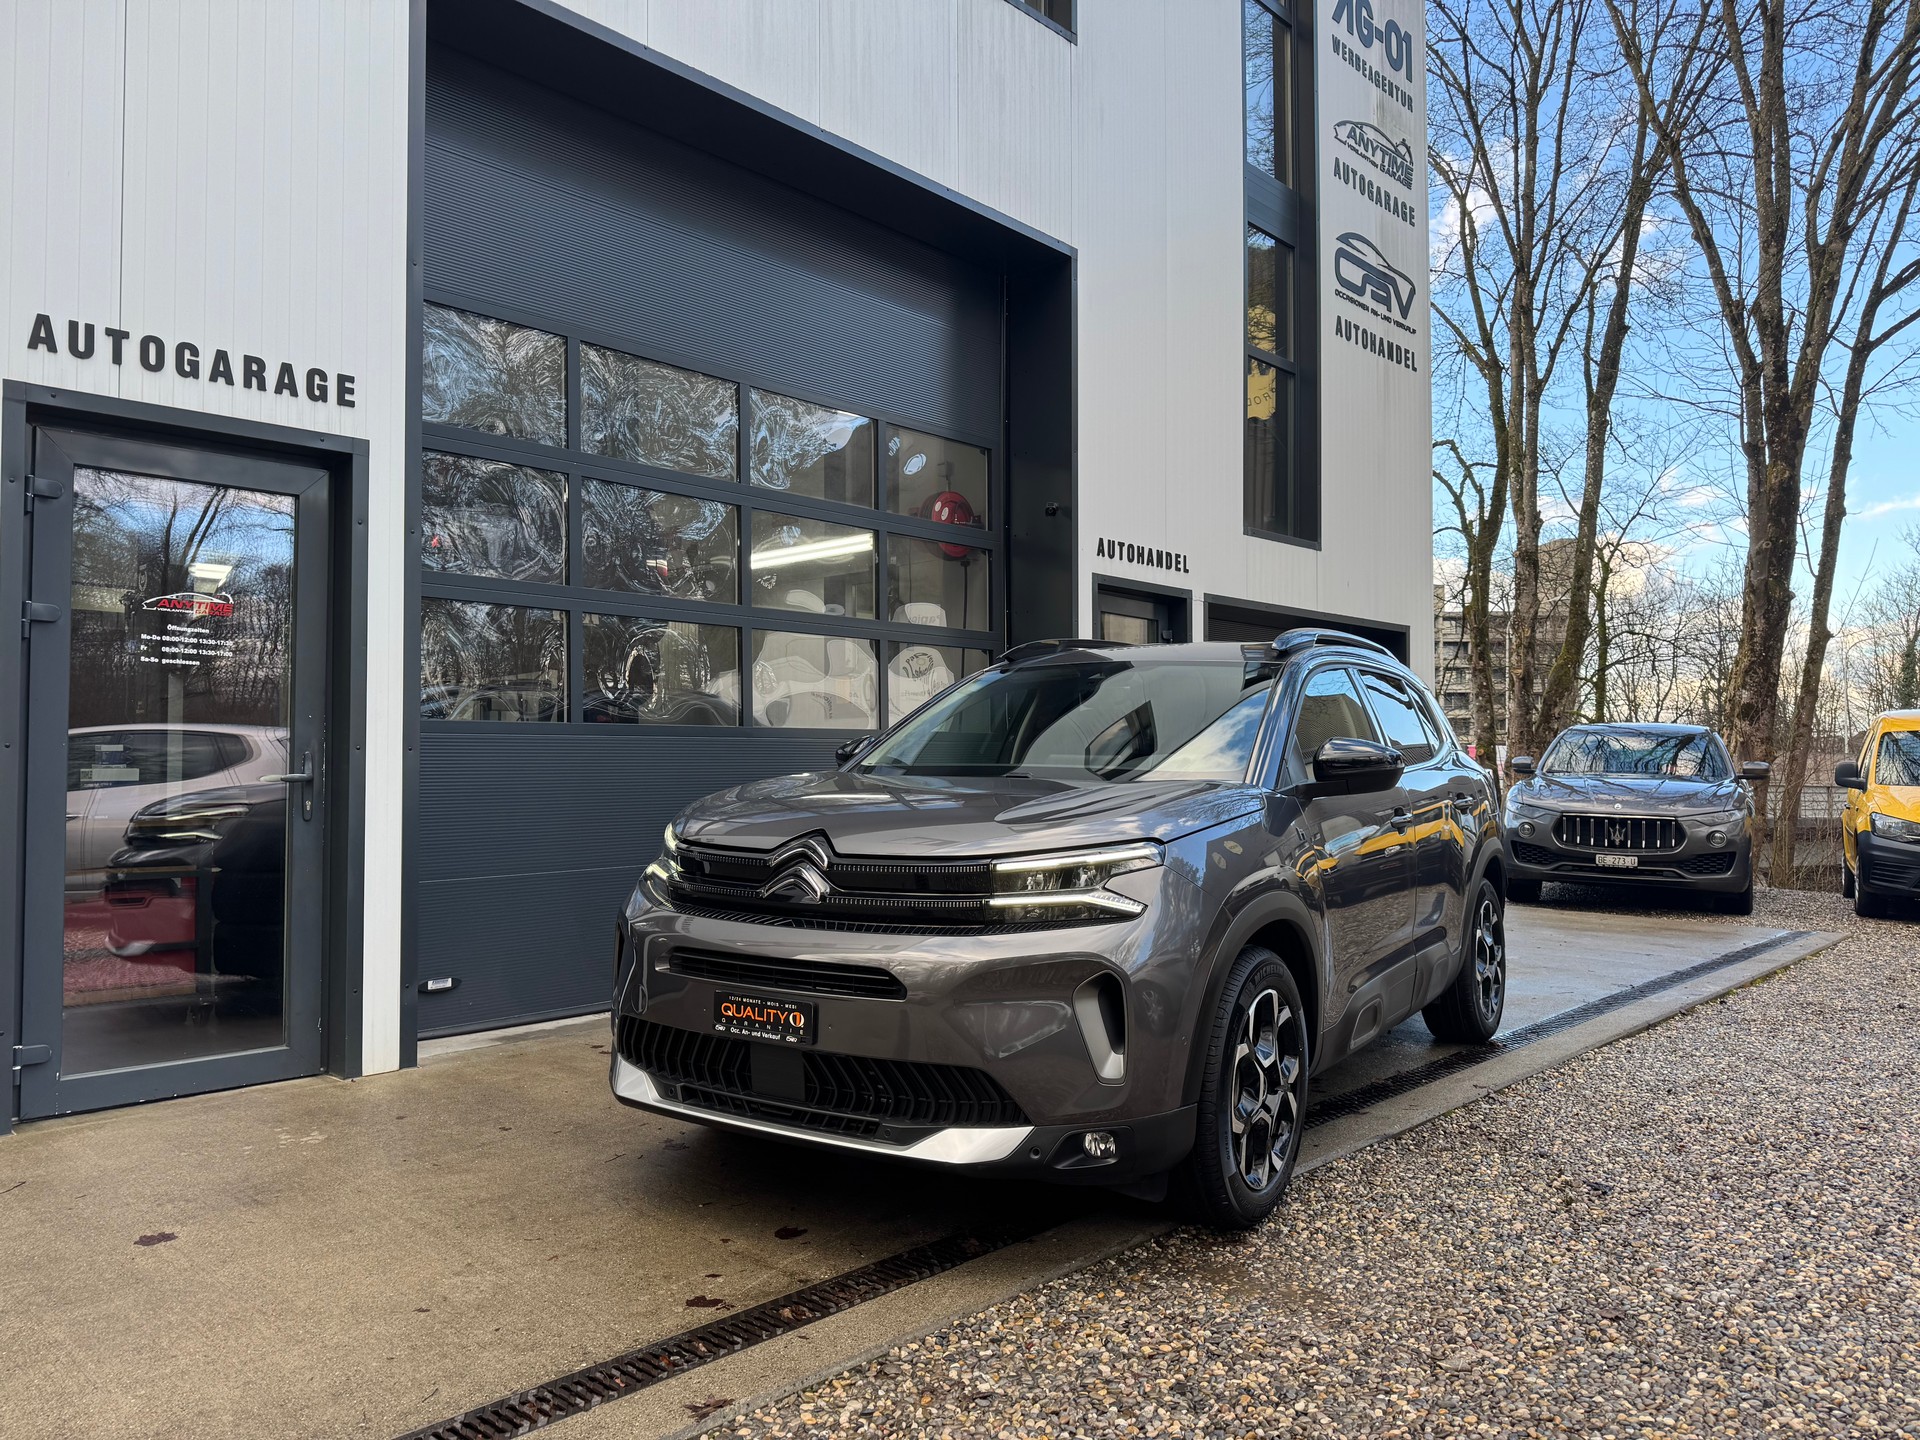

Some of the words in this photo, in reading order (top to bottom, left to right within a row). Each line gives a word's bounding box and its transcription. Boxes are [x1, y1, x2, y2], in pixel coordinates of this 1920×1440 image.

[1331, 33, 1413, 113] WERBEAGENTUR
[1346, 126, 1414, 181] ANYTIME
[1379, 163, 1412, 191] GARAGE
[1333, 156, 1416, 228] AUTOGARAGE
[1335, 314, 1418, 373] AUTOHANDEL
[27, 312, 357, 408] AUTOGARAGE
[1096, 537, 1190, 574] AUTOHANDEL
[156, 598, 234, 613] ANYTIME
[194, 609, 233, 617] GARAGE
[140, 633, 161, 641] Mo-Do
[161, 635, 198, 644] 08:00-12:00
[161, 658, 201, 667] geschlossen
[721, 1002, 788, 1024] QUALITY
[742, 996, 761, 1005] MONATE
[730, 1026, 741, 1034] Occ.
[741, 1028, 751, 1036] An-
[761, 1031, 781, 1041] Verkauf
